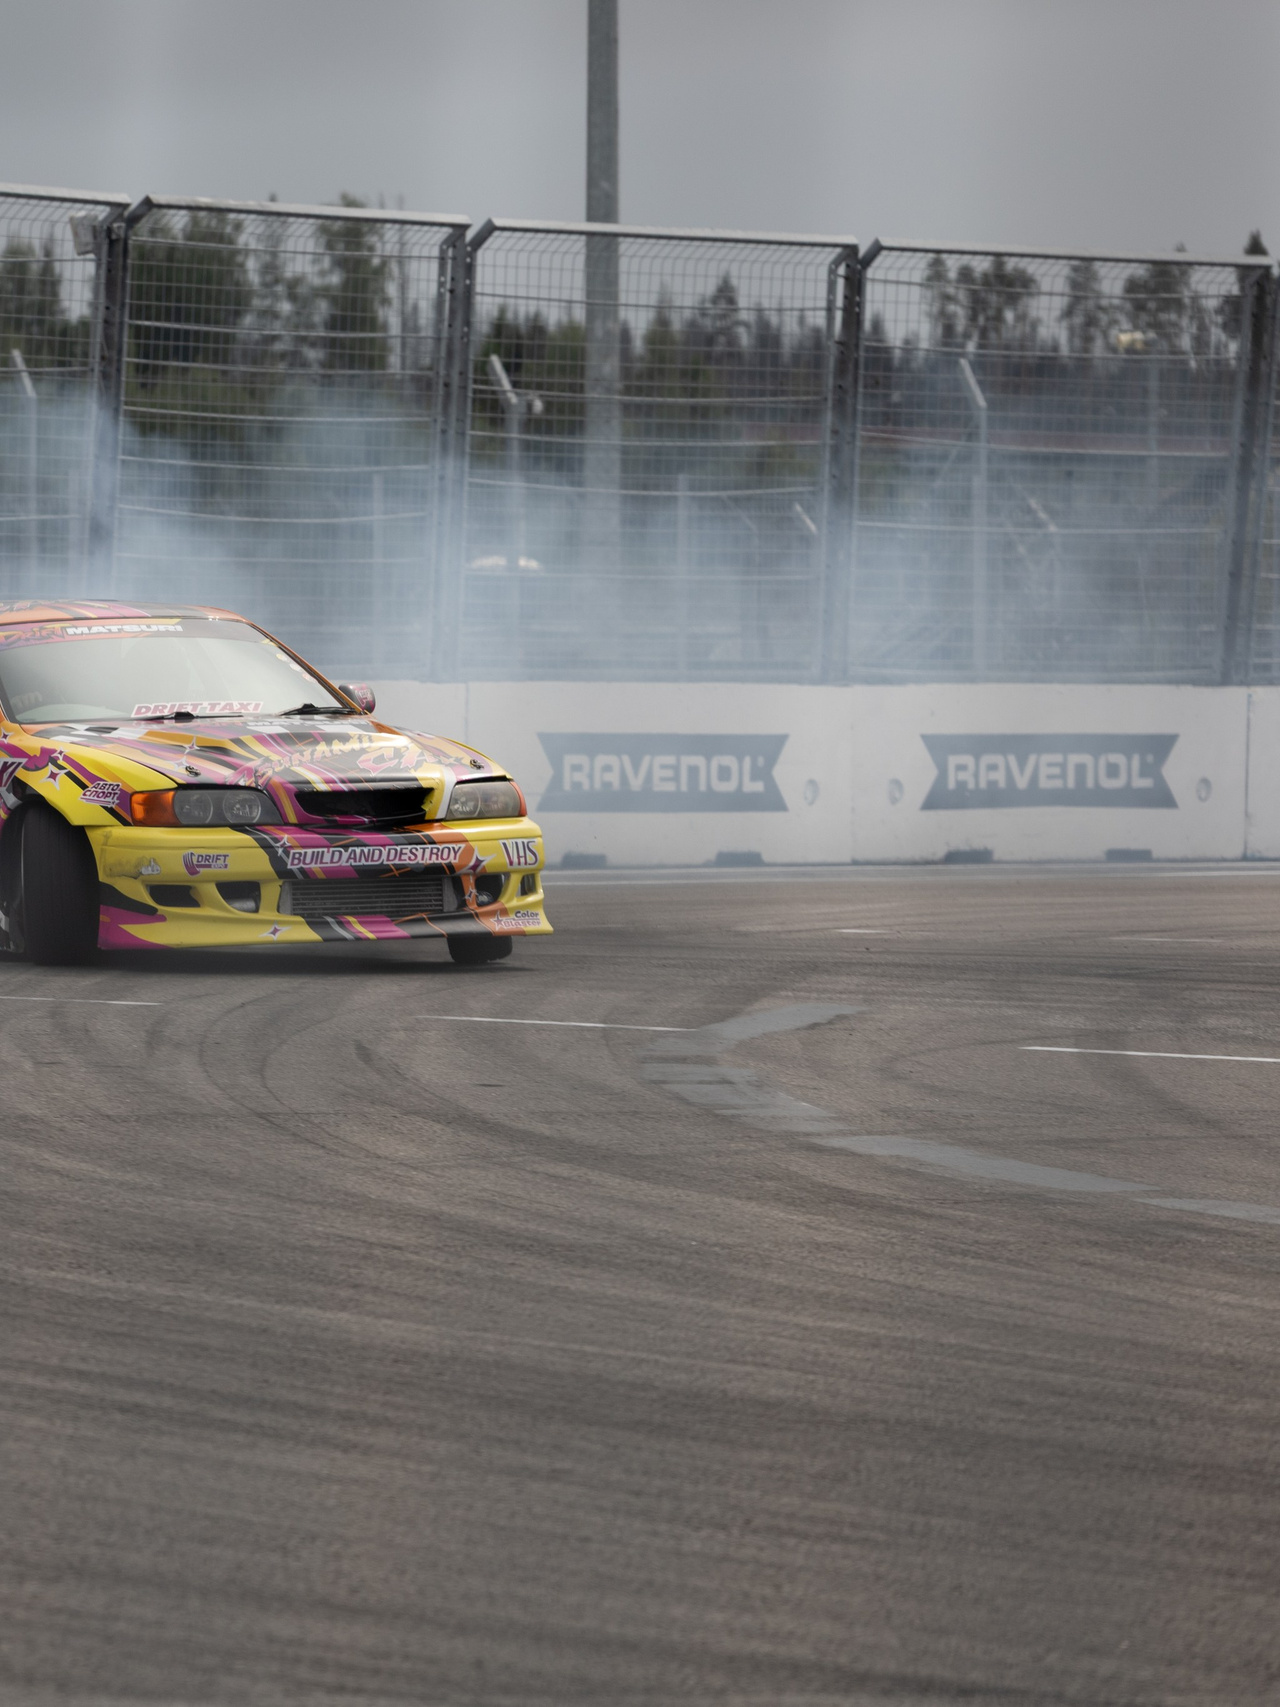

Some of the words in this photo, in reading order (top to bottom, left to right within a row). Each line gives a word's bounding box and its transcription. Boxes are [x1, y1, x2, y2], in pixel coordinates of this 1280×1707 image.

[66, 624, 184, 635] MATSURI
[133, 703, 203, 716] DRIFT
[206, 702, 262, 712] TAXI
[563, 754, 765, 793] RAVENOL
[947, 752, 1154, 791] RAVENOL
[91, 782, 121, 791] АВТО
[82, 790, 119, 800] СПОРТ
[196, 854, 230, 863] DRIFT
[290, 849, 342, 866] BUILD
[346, 848, 383, 863] AND
[386, 845, 464, 862] DESTROY
[501, 840, 539, 867] VHS
[500, 919, 541, 928] Blaster
